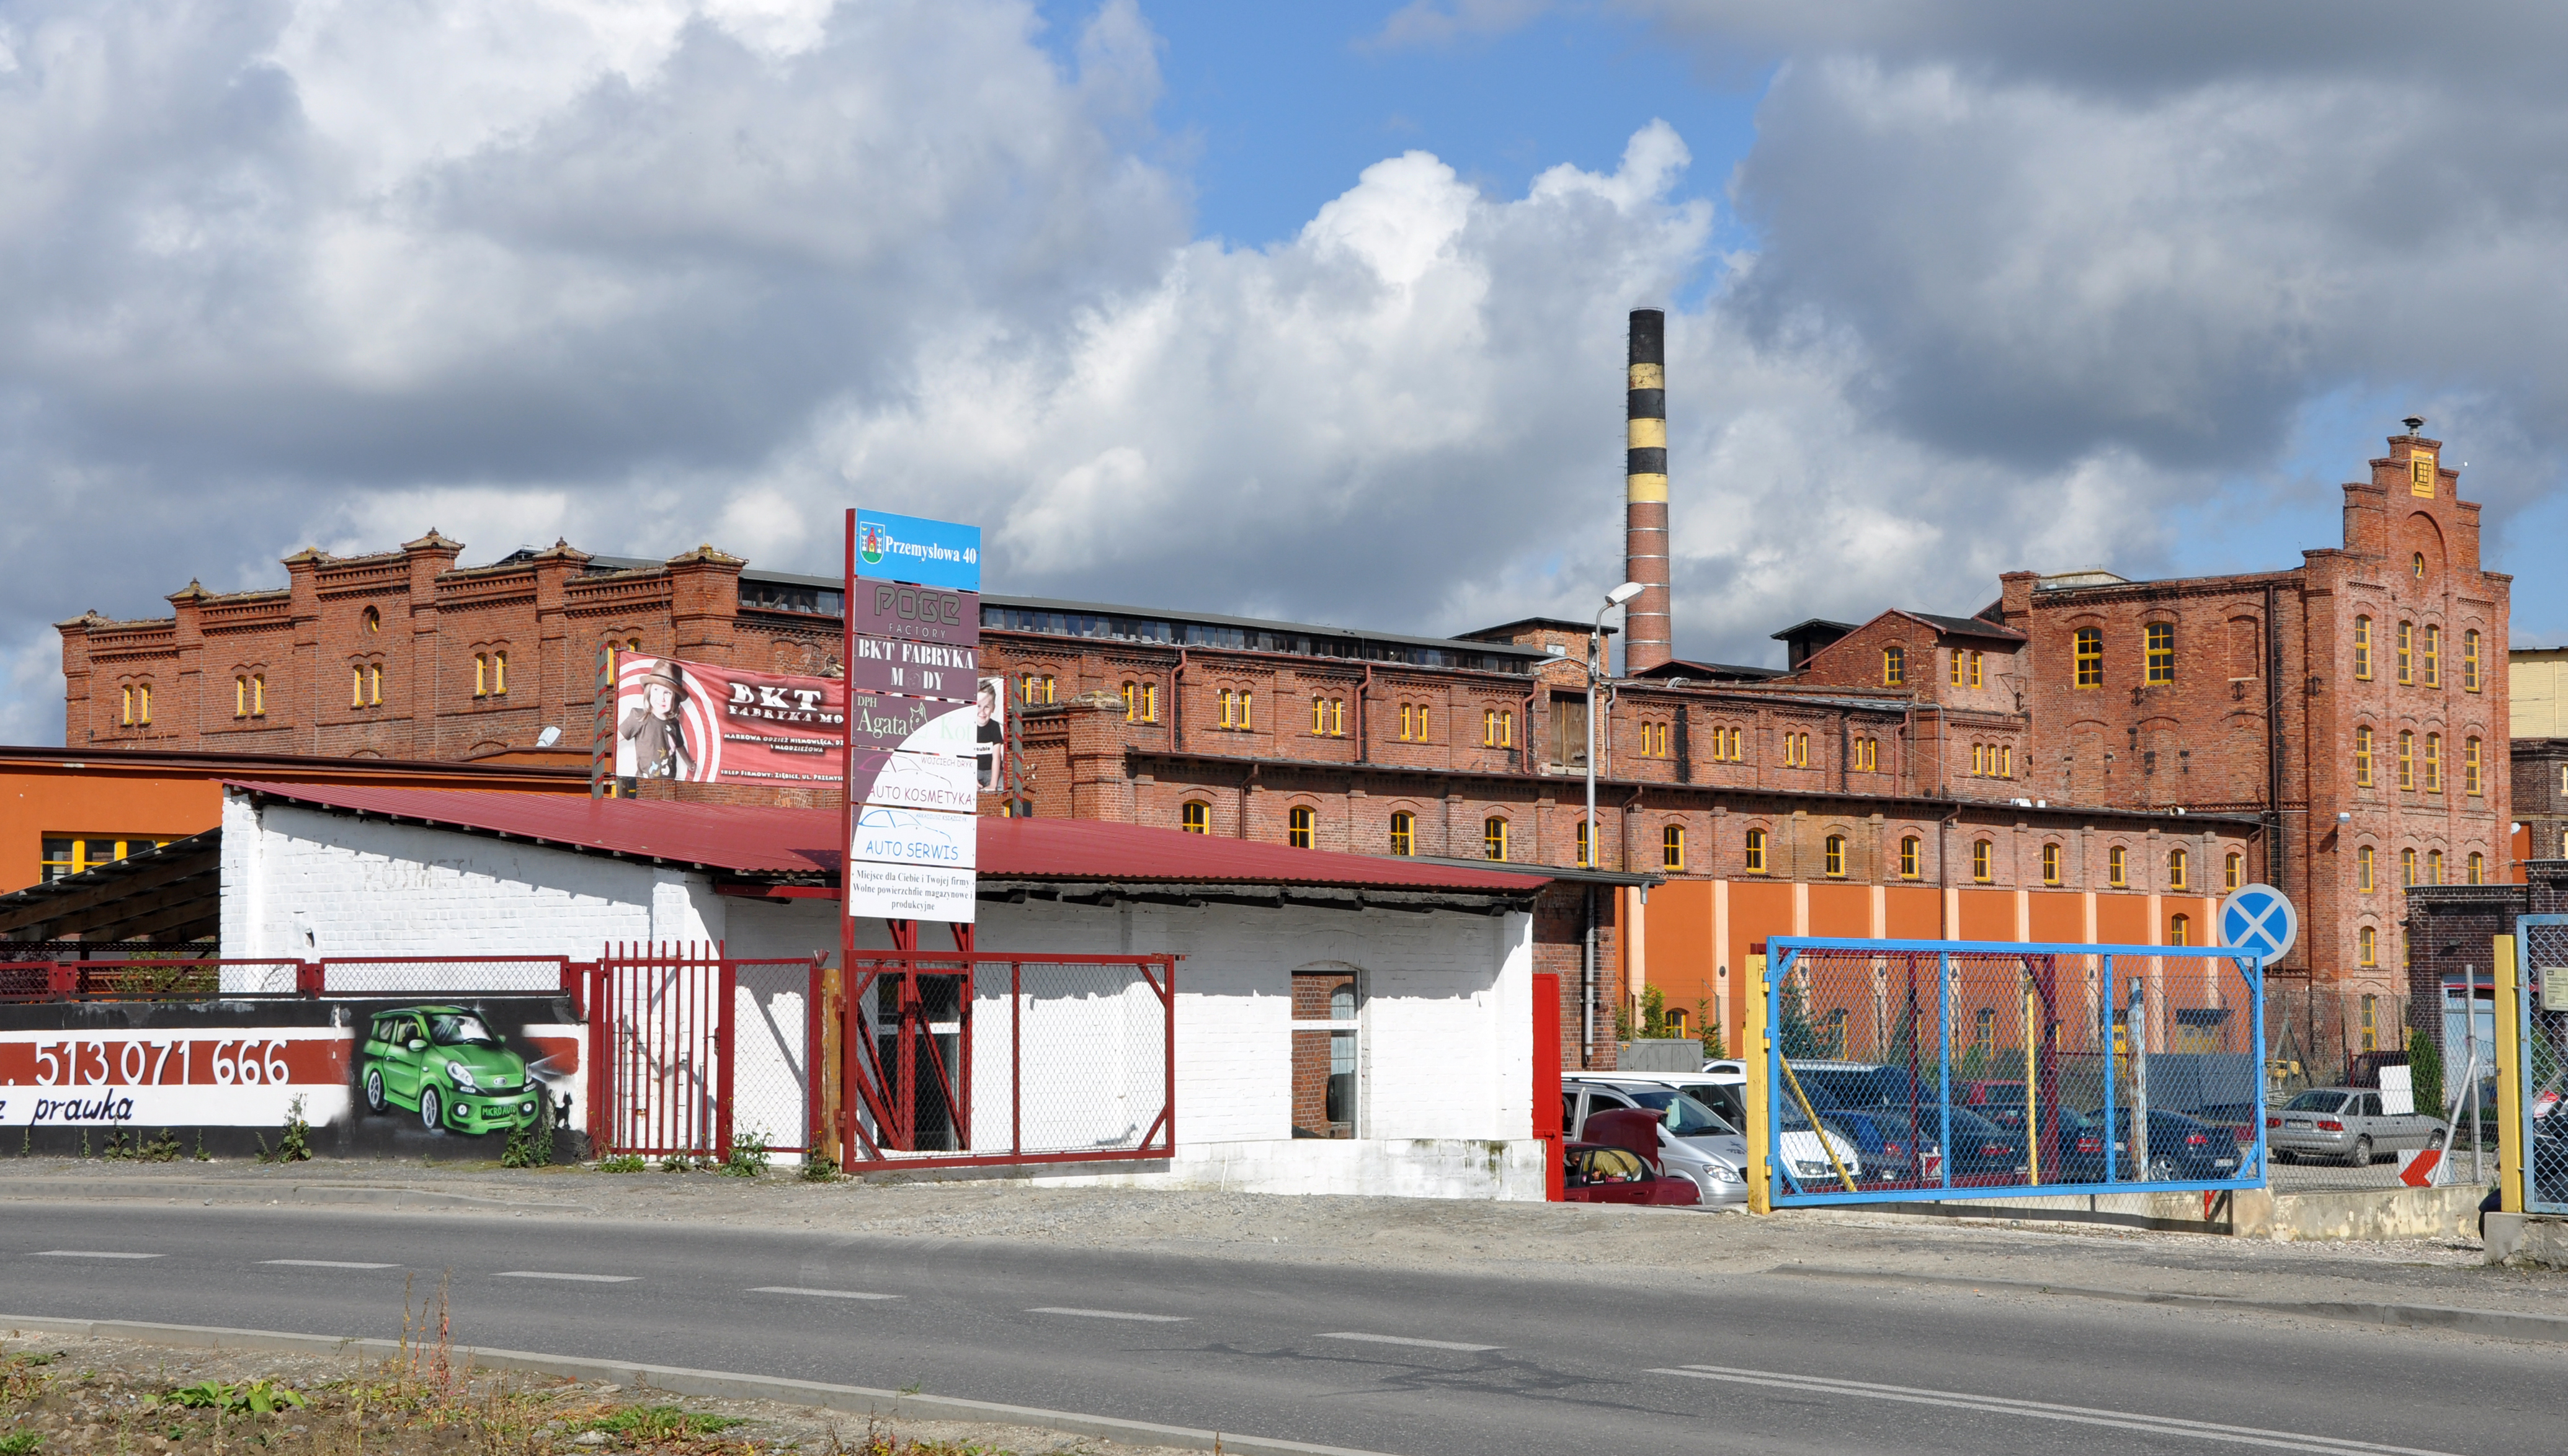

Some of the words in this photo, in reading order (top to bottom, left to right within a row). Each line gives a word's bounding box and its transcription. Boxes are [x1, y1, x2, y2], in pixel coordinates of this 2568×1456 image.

[885, 535, 960, 562] Przemysłowa
[963, 547, 977, 564] 40
[889, 623, 946, 639] FACTORY
[858, 639, 895, 661] BKT
[902, 643, 974, 670] FABRYKA
[891, 667, 944, 690] MDY
[729, 683, 822, 711] BKT
[857, 696, 877, 708] DPH
[728, 704, 813, 722] FABRYKA
[857, 708, 908, 739] Agata
[940, 716, 973, 742] Kot
[723, 733, 762, 742] MARKOWA
[921, 756, 955, 766] WOJCIECH
[956, 759, 973, 768] DRYK
[868, 785, 901, 800] AUTO
[904, 788, 972, 806] KOSMETYKA
[865, 840, 903, 856] AUTO
[906, 842, 959, 861] SERWIS
[857, 869, 884, 882] Miejsce
[885, 872, 896, 881] dla
[898, 872, 920, 883] Ciebie
[925, 874, 950, 887] Twojej
[951, 876, 970, 889] firmy
[853, 883, 876, 893] Wolne
[924, 889, 970, 900] magazynowe
[891, 900, 935, 912] produkcyjne
[35, 1041, 110, 1086] 513
[120, 1041, 190, 1085] 071
[212, 1040, 290, 1085] 666
[30, 1088, 134, 1125] prawka
[482, 1106, 502, 1116] MICRO
